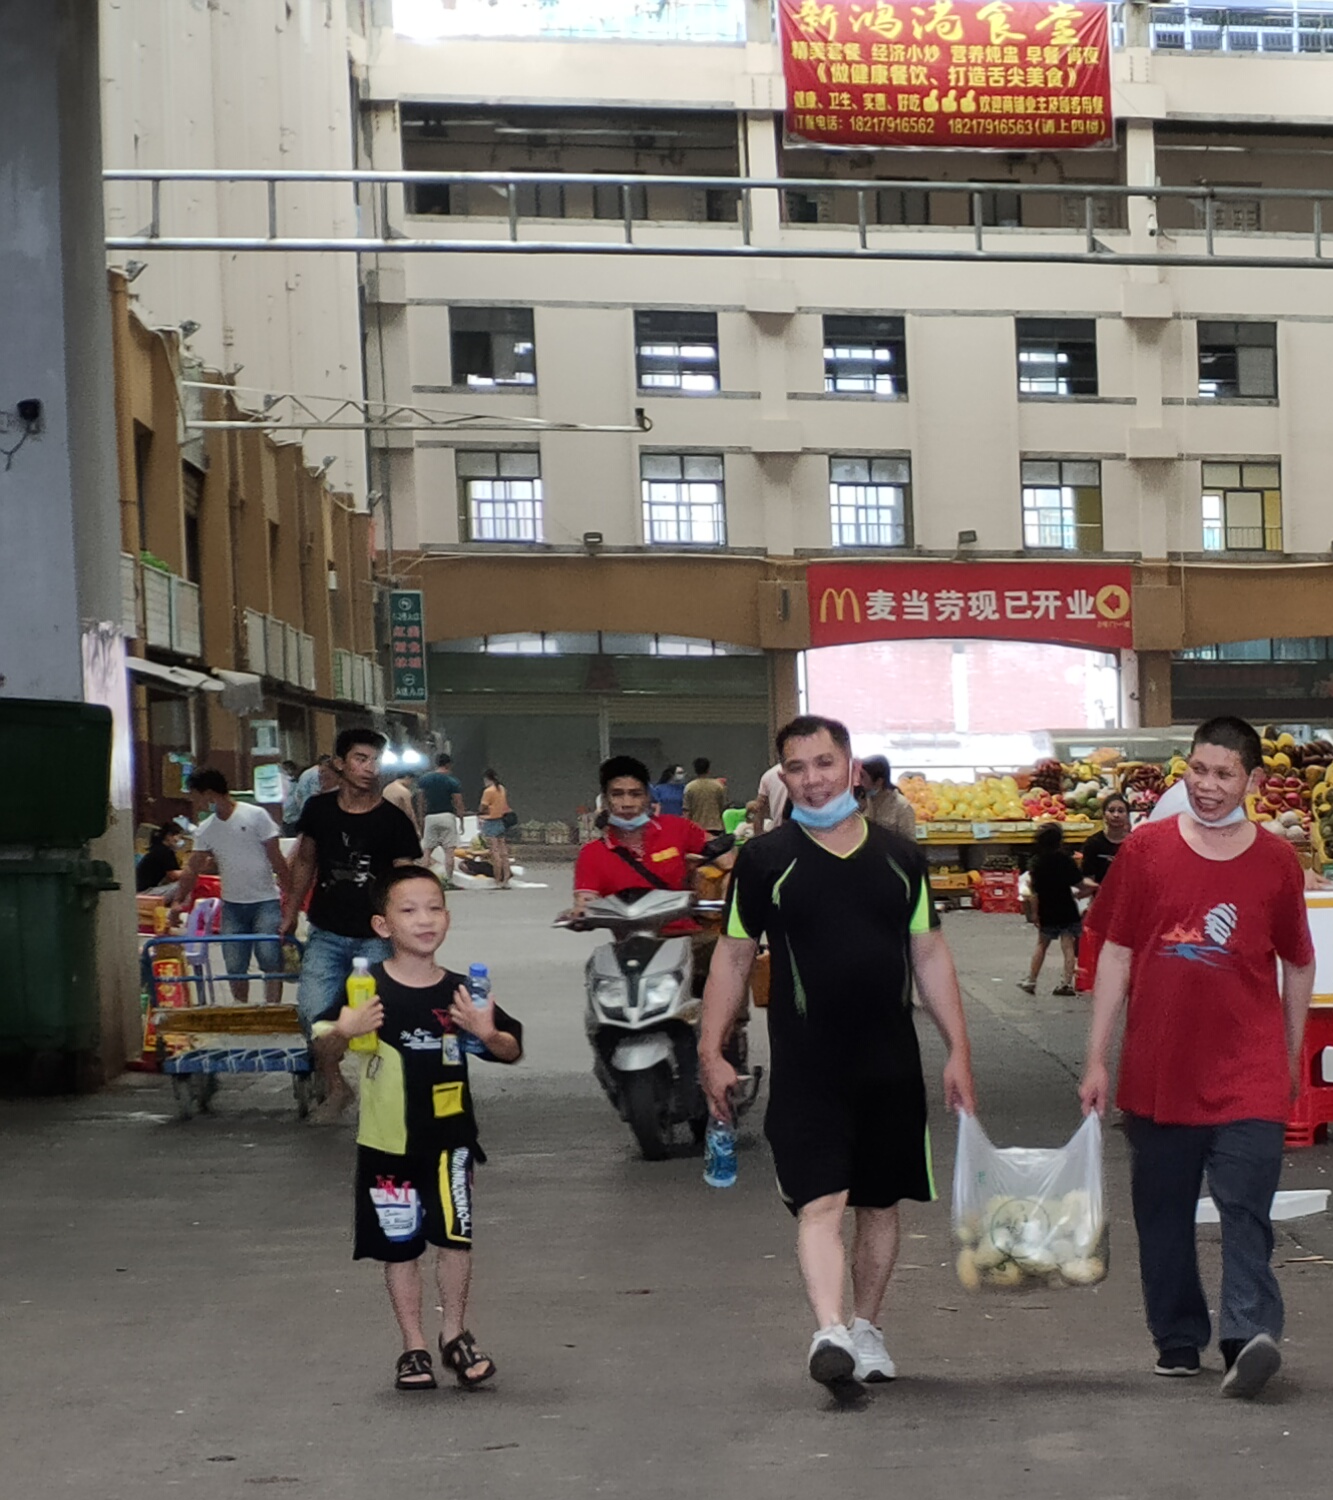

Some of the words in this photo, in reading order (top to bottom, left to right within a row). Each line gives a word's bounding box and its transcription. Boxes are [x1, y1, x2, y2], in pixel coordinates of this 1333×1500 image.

[792, 41, 860, 61] 精美套餐
[871, 43, 940, 63] 经济小炒
[1025, 46, 1058, 65] 早餐
[866, 588, 1097, 622] 麦当劳现已开业
